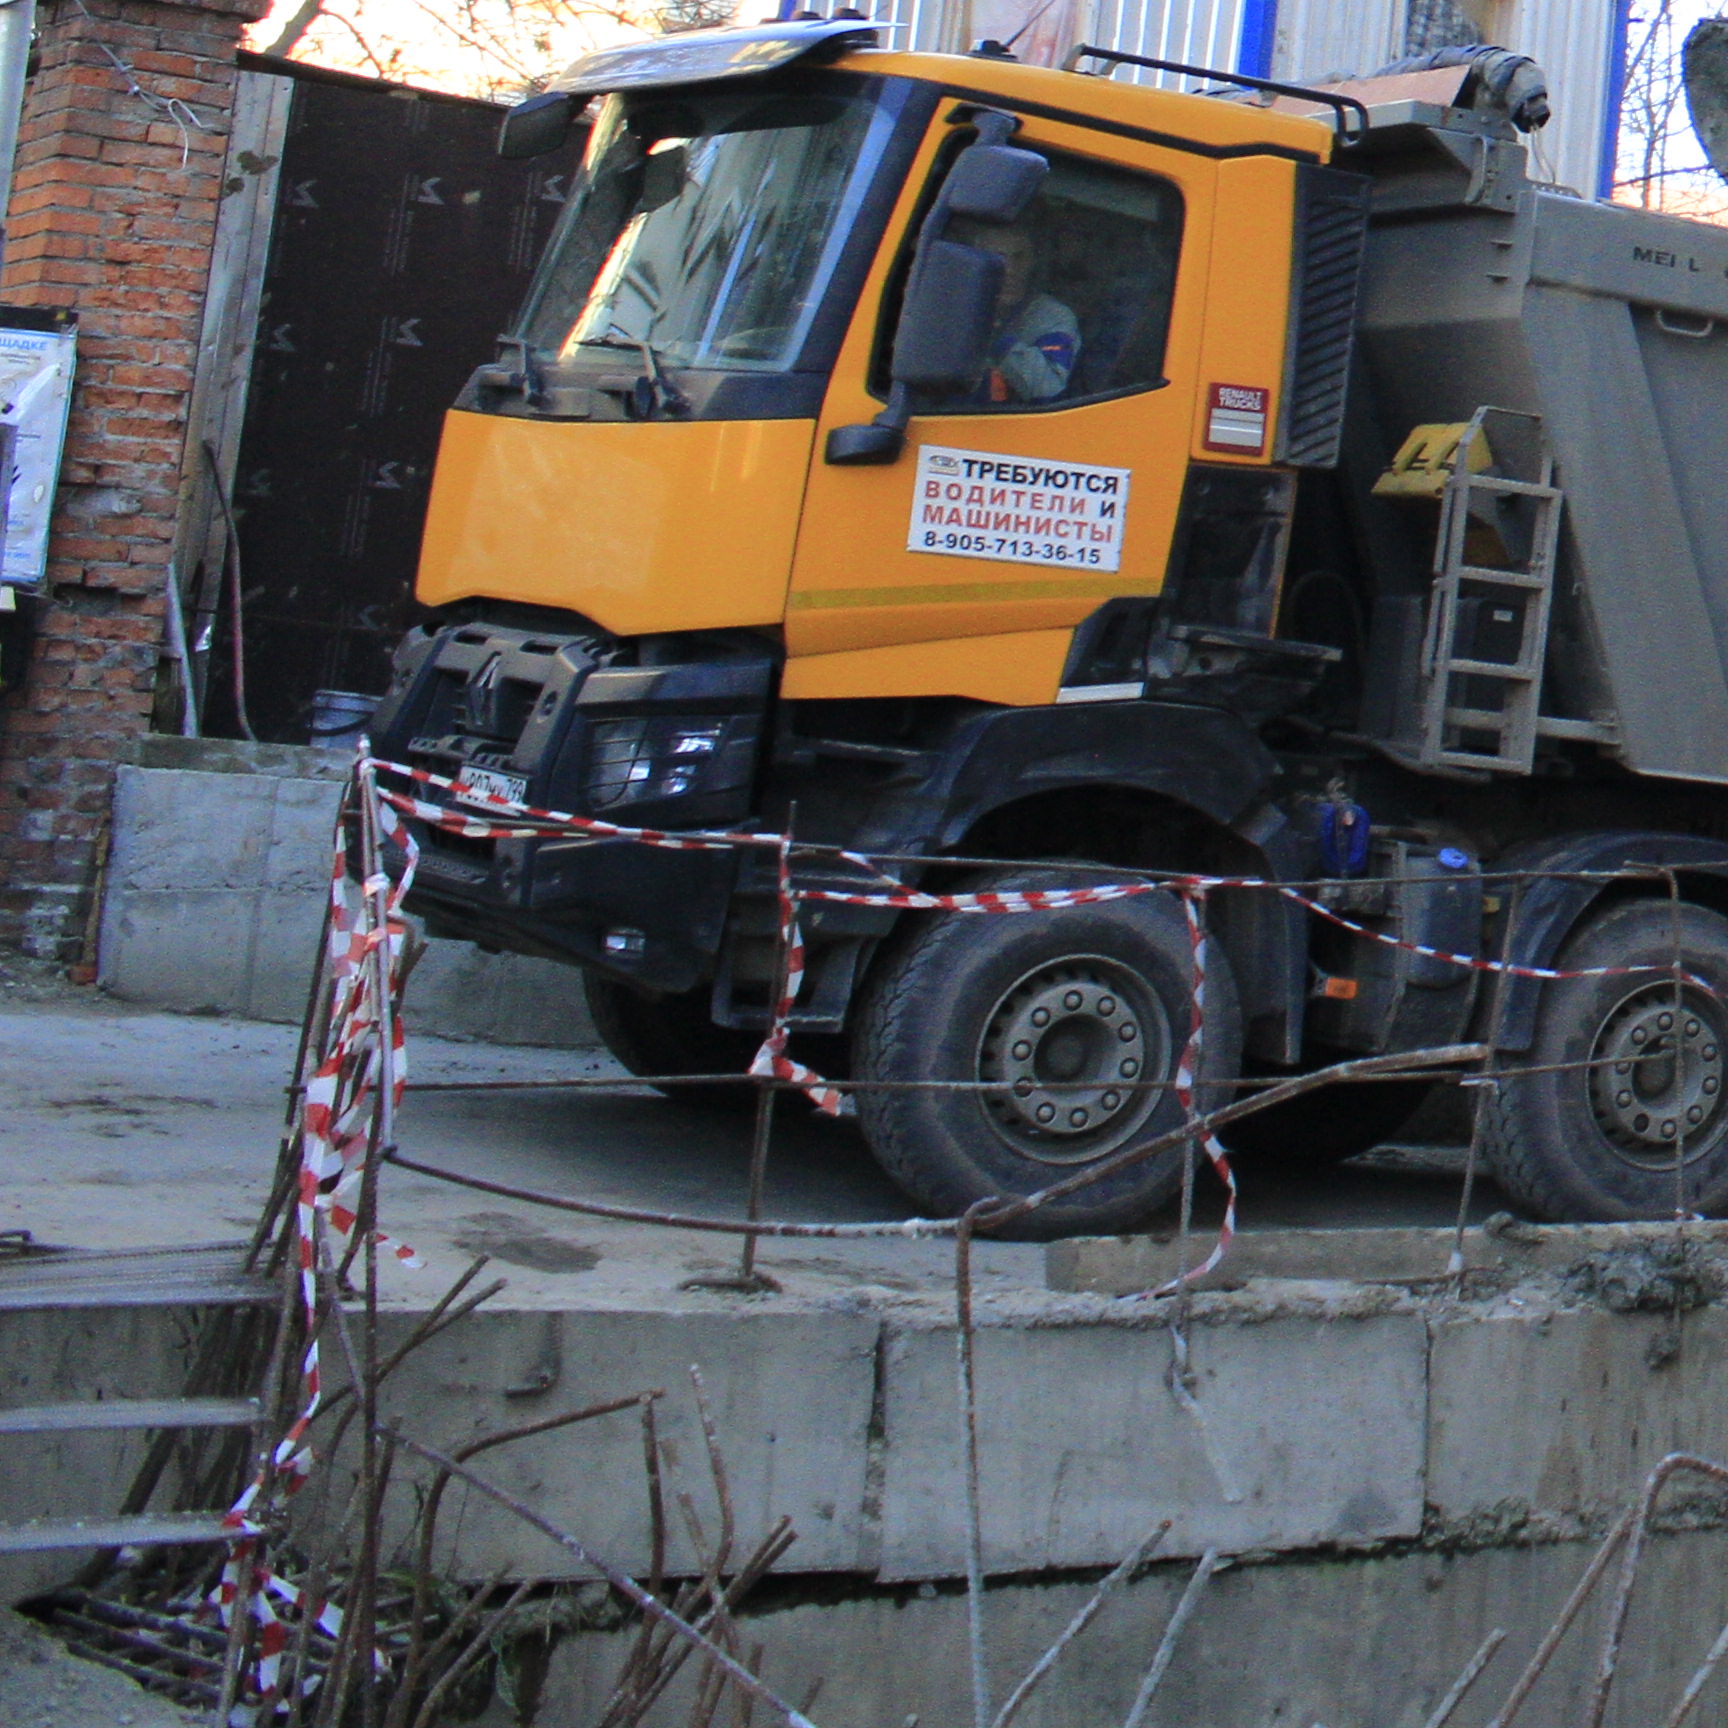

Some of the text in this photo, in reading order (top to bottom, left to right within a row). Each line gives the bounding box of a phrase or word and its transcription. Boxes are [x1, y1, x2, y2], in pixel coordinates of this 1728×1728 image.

[1218, 387, 1262, 400] RENAULT
[1219, 397, 1261, 410] TRUCKS
[962, 458, 1118, 494] ТРЕБУЮТСЯ
[924, 480, 1116, 519] ВОДИТЕЛИ И
[922, 503, 1113, 544] МАШИНИСТЫ
[924, 530, 1101, 564] 8-905-713-36-15
